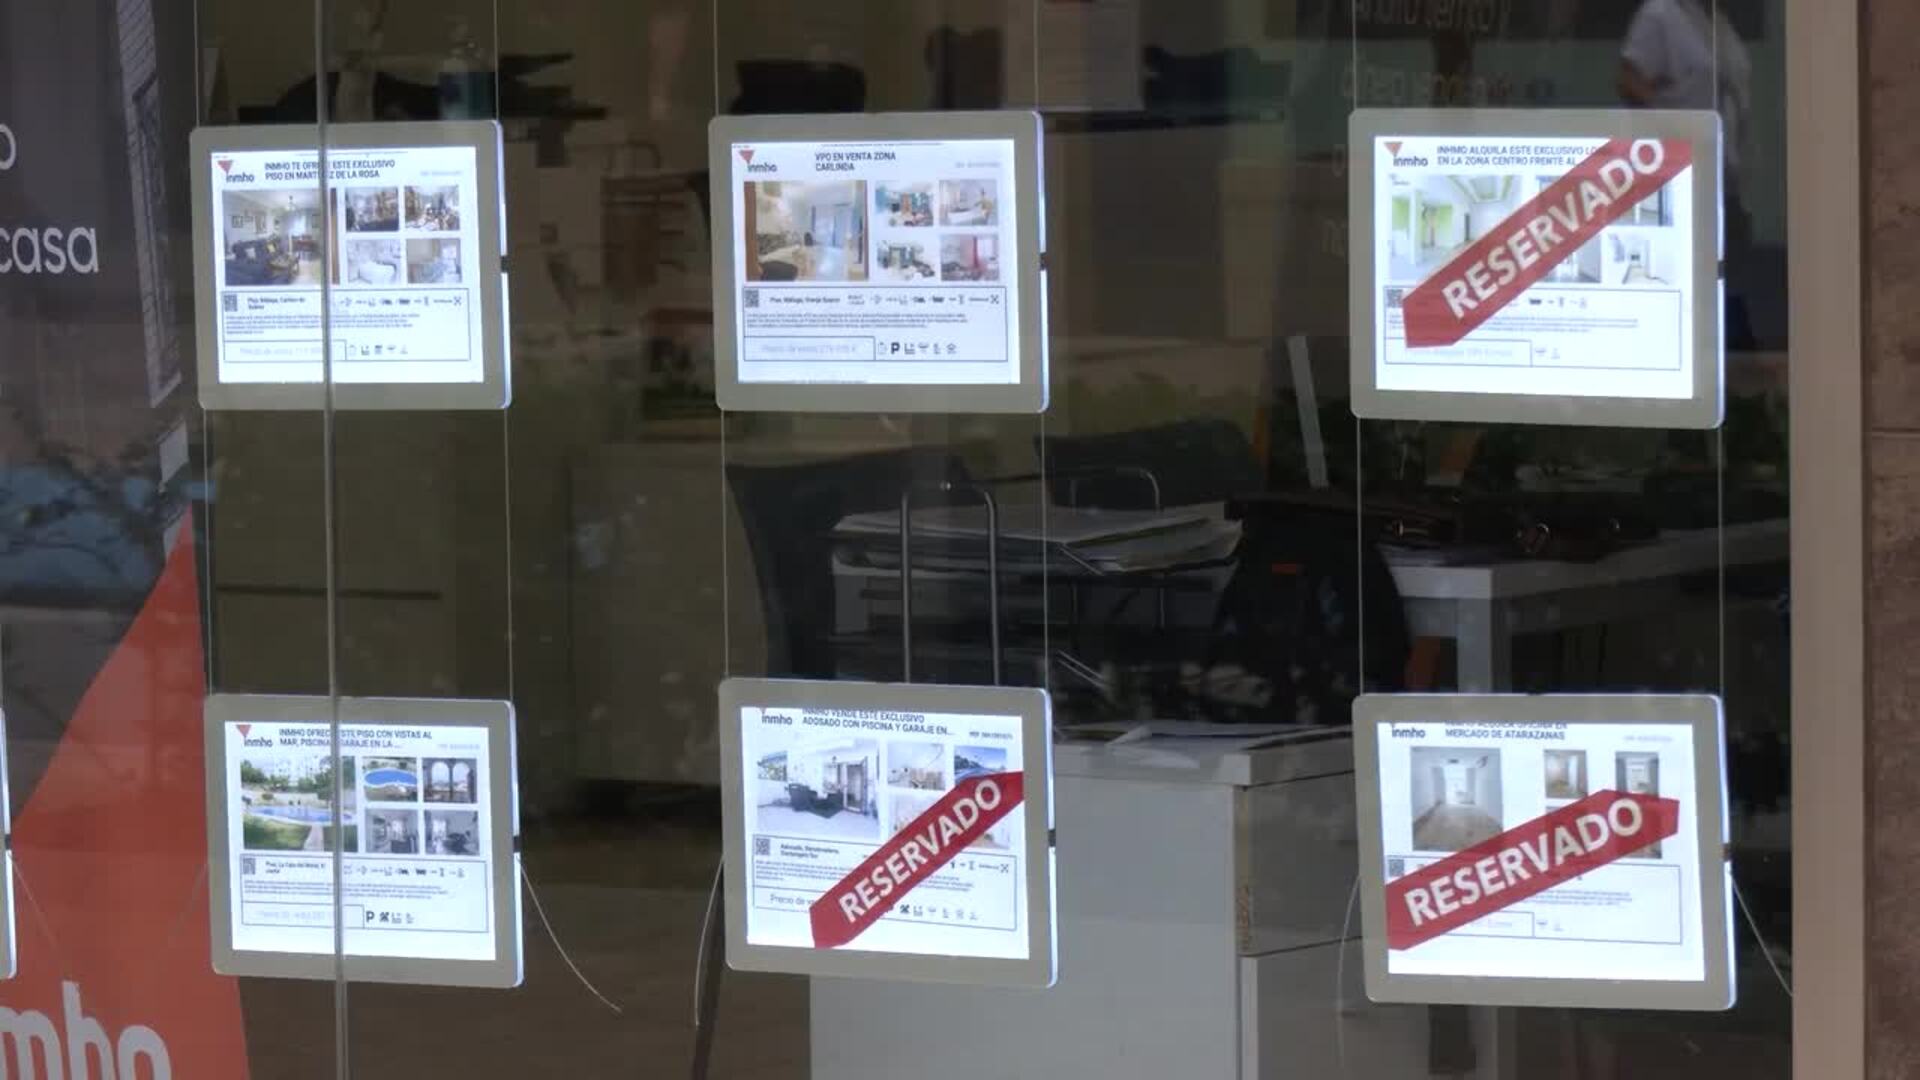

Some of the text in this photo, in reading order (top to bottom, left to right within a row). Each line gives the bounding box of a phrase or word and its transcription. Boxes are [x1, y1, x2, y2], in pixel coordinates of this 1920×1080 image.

[1470, 145, 1508, 154] ALQUILA
[1509, 145, 1531, 155] ESTE
[1534, 146, 1584, 155] EXCLUSIVO
[815, 151, 896, 161] VPO EN VENTA ZONA
[1393, 155, 1428, 167] inmho
[1437, 156, 1450, 165] EN
[1451, 156, 1463, 165] LA
[1464, 156, 1490, 165] ZONA
[1491, 156, 1528, 166] CENTRO
[1530, 156, 1564, 166] FRENTE
[291, 161, 301, 169] TE
[332, 160, 351, 169] ESTE
[352, 159, 395, 168] EXCLUSIVO
[748, 162, 777, 172] inmho
[815, 162, 855, 171] CARLINDA
[226, 172, 254, 182] inmho
[265, 171, 283, 180] PISO
[284, 171, 294, 179] EN
[335, 170, 346, 179] DE
[347, 170, 357, 178] LA
[358, 169, 380, 178] ROSA
[1442, 139, 1665, 319] RESERVADO
[762, 714, 793, 725] inmho
[831, 708, 858, 718] VENDE
[860, 709, 878, 719] ESTE
[880, 711, 925, 723] EXCLUSIVO
[802, 716, 841, 727] ADOSADO
[842, 719, 861, 729] CON
[861, 720, 893, 731] PISCINA
[894, 722, 902, 732] Y
[902, 723, 935, 735] GARAJE
[357, 730, 375, 738] PISO
[376, 730, 393, 738] CON
[393, 730, 421, 739] VISTAS
[423, 731, 433, 740] AL
[1392, 727, 1425, 738] inmho
[1445, 728, 1565, 740] MERCADO DE ATARAZANAS
[244, 737, 273, 747] inmho
[370, 740, 381, 748] EN
[382, 740, 393, 748] LA
[838, 779, 1002, 923] RESERVADO
[1404, 798, 1643, 927] RESERVADO
